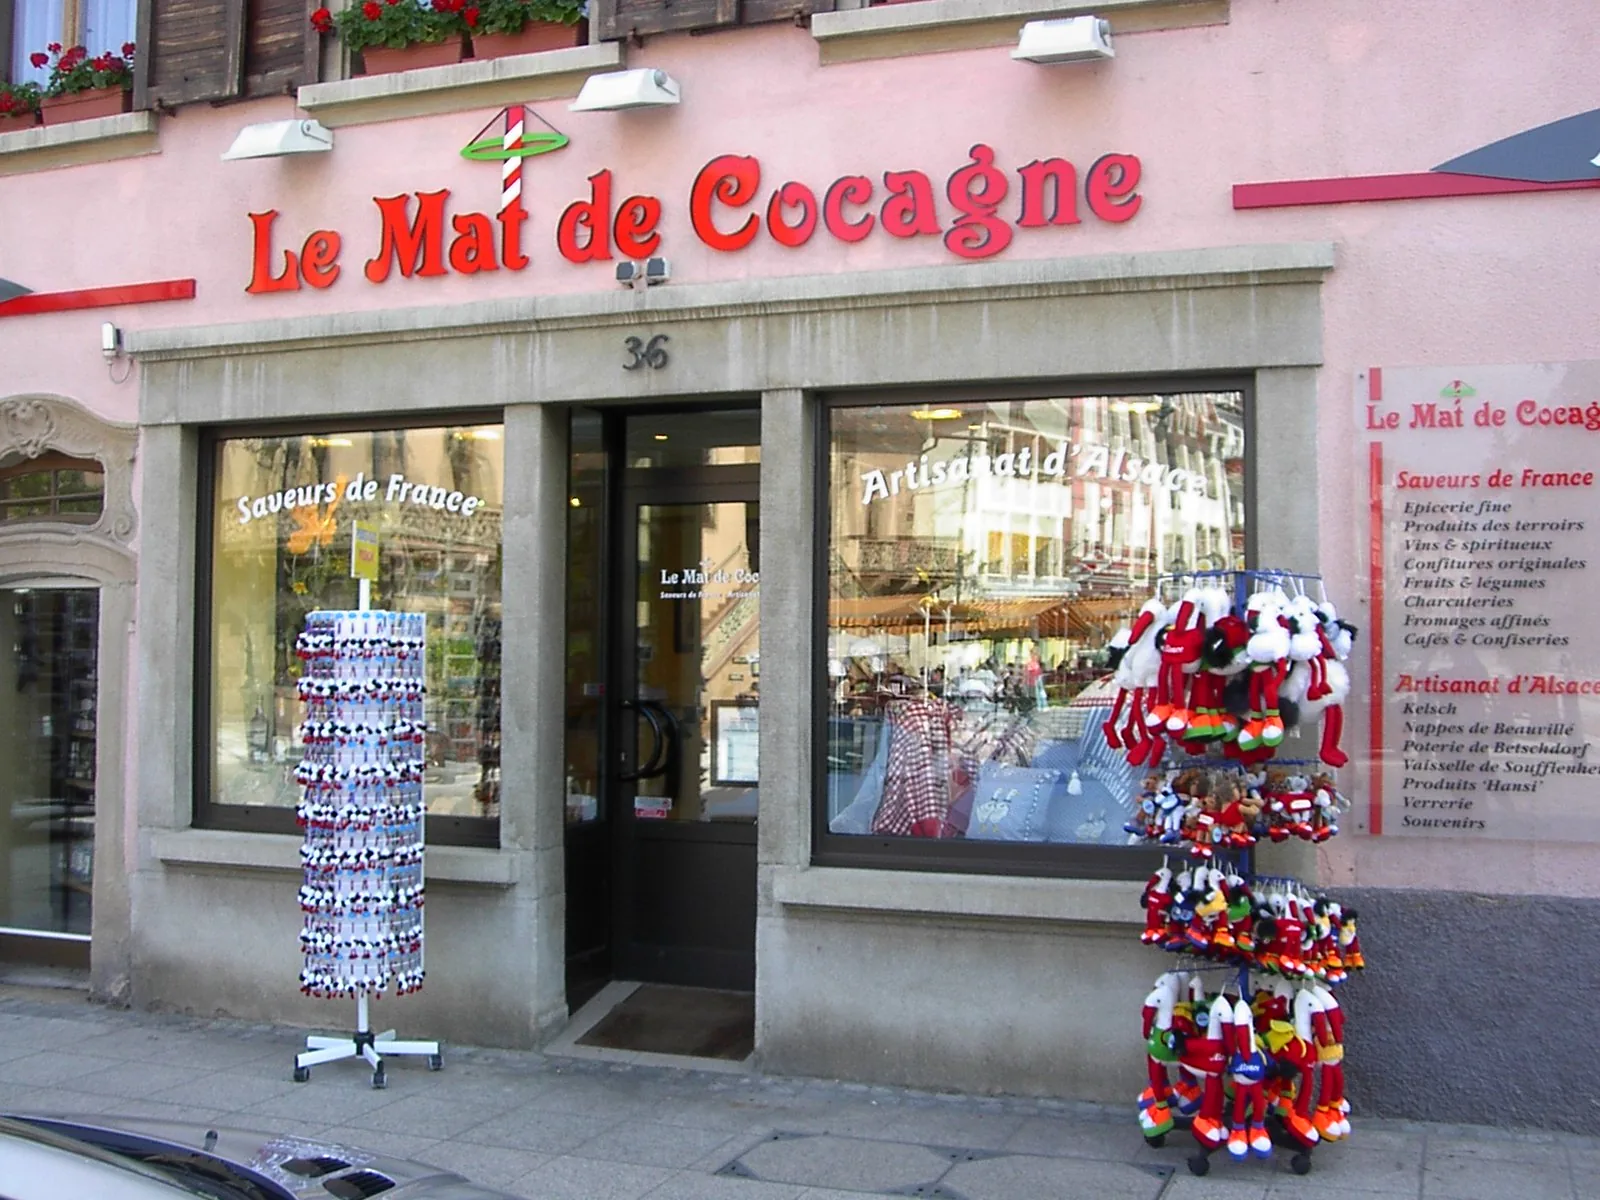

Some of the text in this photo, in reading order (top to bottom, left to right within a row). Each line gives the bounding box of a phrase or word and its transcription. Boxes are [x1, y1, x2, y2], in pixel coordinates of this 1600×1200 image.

[245, 143, 1142, 294] Le Mat de Cocagne
[622, 334, 669, 371] 36
[1366, 400, 1600, 431] Le Mat de Cocag
[860, 442, 1207, 505] Artisanat d'Alsace
[1397, 469, 1593, 489] Saveurs de France
[237, 472, 478, 524] Saveurs de France
[1403, 500, 1512, 517] Epicerie fine
[1403, 518, 1585, 532] Produits des terroirs
[1403, 537, 1552, 554] Vins & spiritueux
[1403, 557, 1587, 573] Confitures originales
[661, 569, 679, 584] Le
[1403, 575, 1546, 591] Fruits & légumes
[1403, 595, 1515, 608] Charcuteries
[1403, 614, 1551, 629] Fromages affinés
[1404, 632, 1569, 648] Cafés & Confiseries
[1394, 674, 1500, 693] Artisanat
[1403, 702, 1457, 715] Kelsch
[1403, 721, 1574, 737] Nappes de Beauvillé
[1403, 740, 1591, 758] Poterie de Betschdorf
[1403, 759, 1475, 772] Vaisselle
[1479, 760, 1499, 773] de
[1403, 778, 1476, 791] Produits
[1403, 797, 1473, 809] Verrerie
[1402, 815, 1486, 829] Souvenirs
